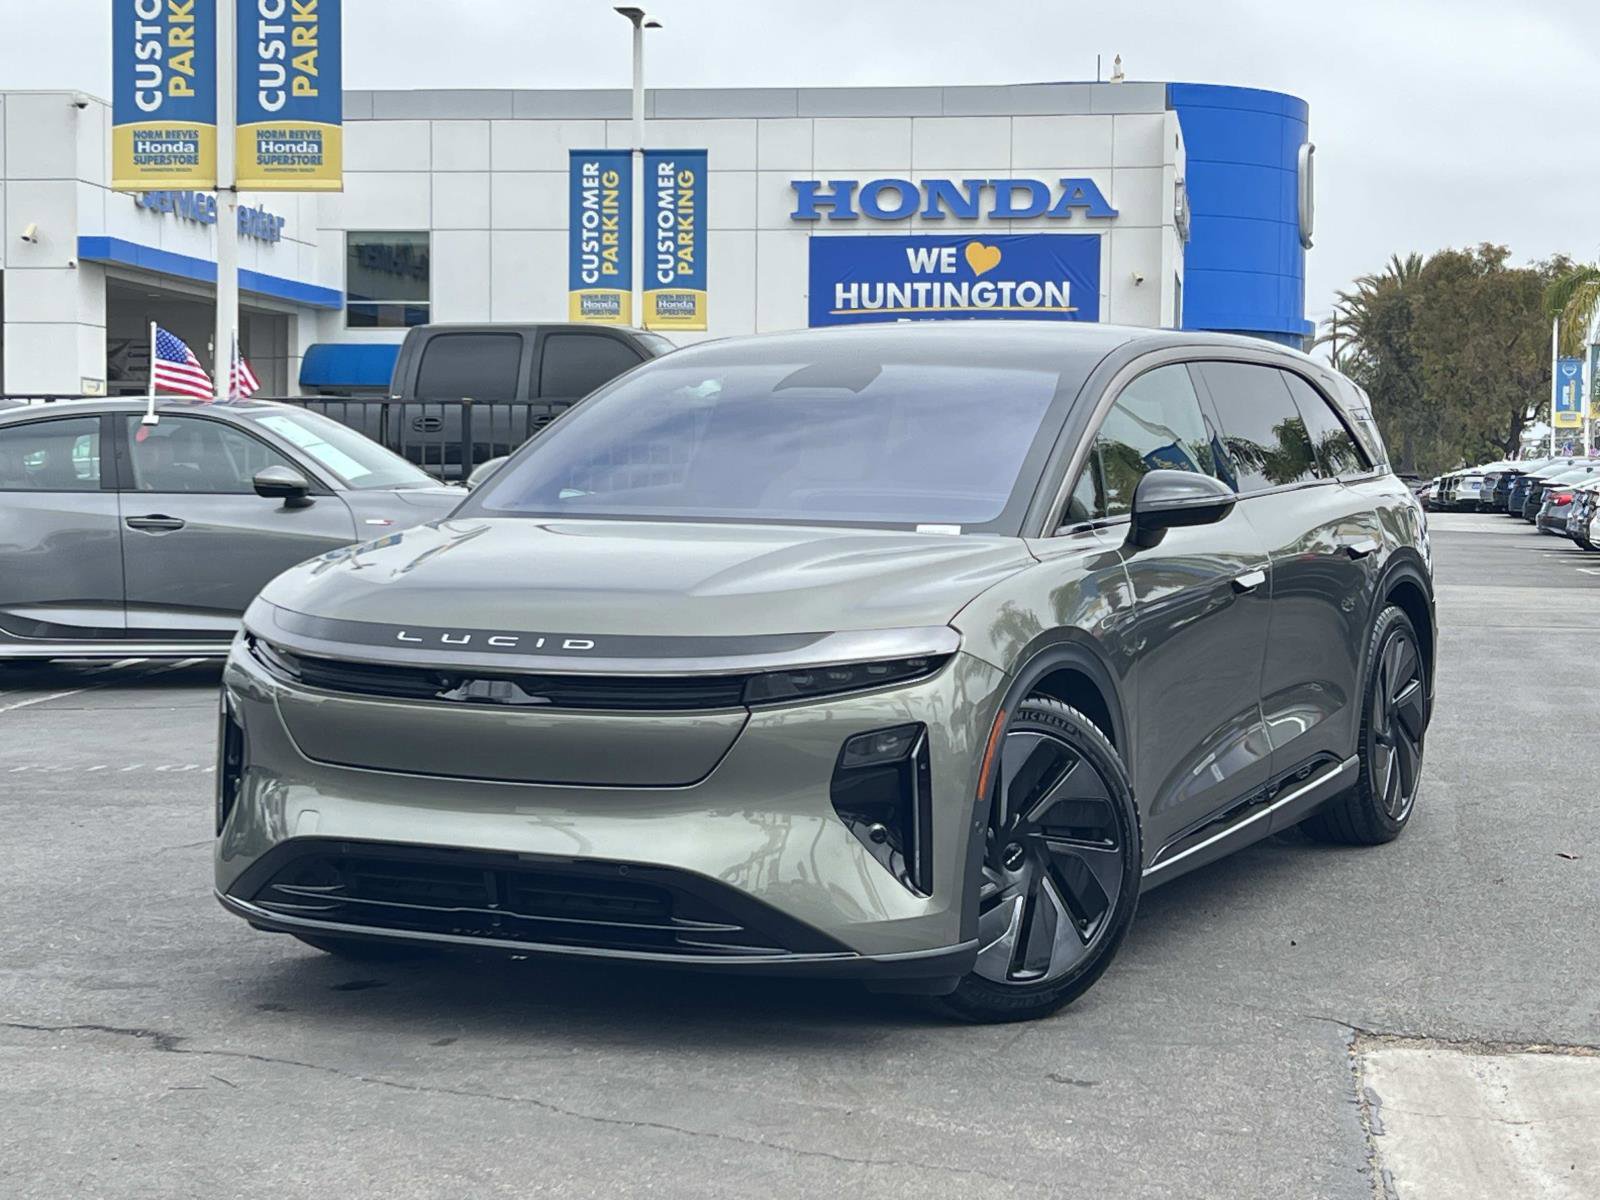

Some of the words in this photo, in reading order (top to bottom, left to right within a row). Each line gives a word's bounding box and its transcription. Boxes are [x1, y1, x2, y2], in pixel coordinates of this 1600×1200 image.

[133, 155, 199, 165] SUPERSTORE
[137, 141, 195, 153] Honda
[256, 155, 323, 165] SUPERSTORE
[261, 141, 318, 153] Honda
[790, 178, 1119, 221] HONDA
[582, 162, 600, 284] CUSTOMER
[602, 170, 619, 275] PARKING
[657, 162, 675, 284] CUSTOMER
[677, 170, 694, 275] PARKING
[906, 247, 957, 274] WE
[658, 301, 693, 309] Honda
[835, 281, 1070, 309] HUNTINGTON
[397, 631, 595, 650] LUCID
